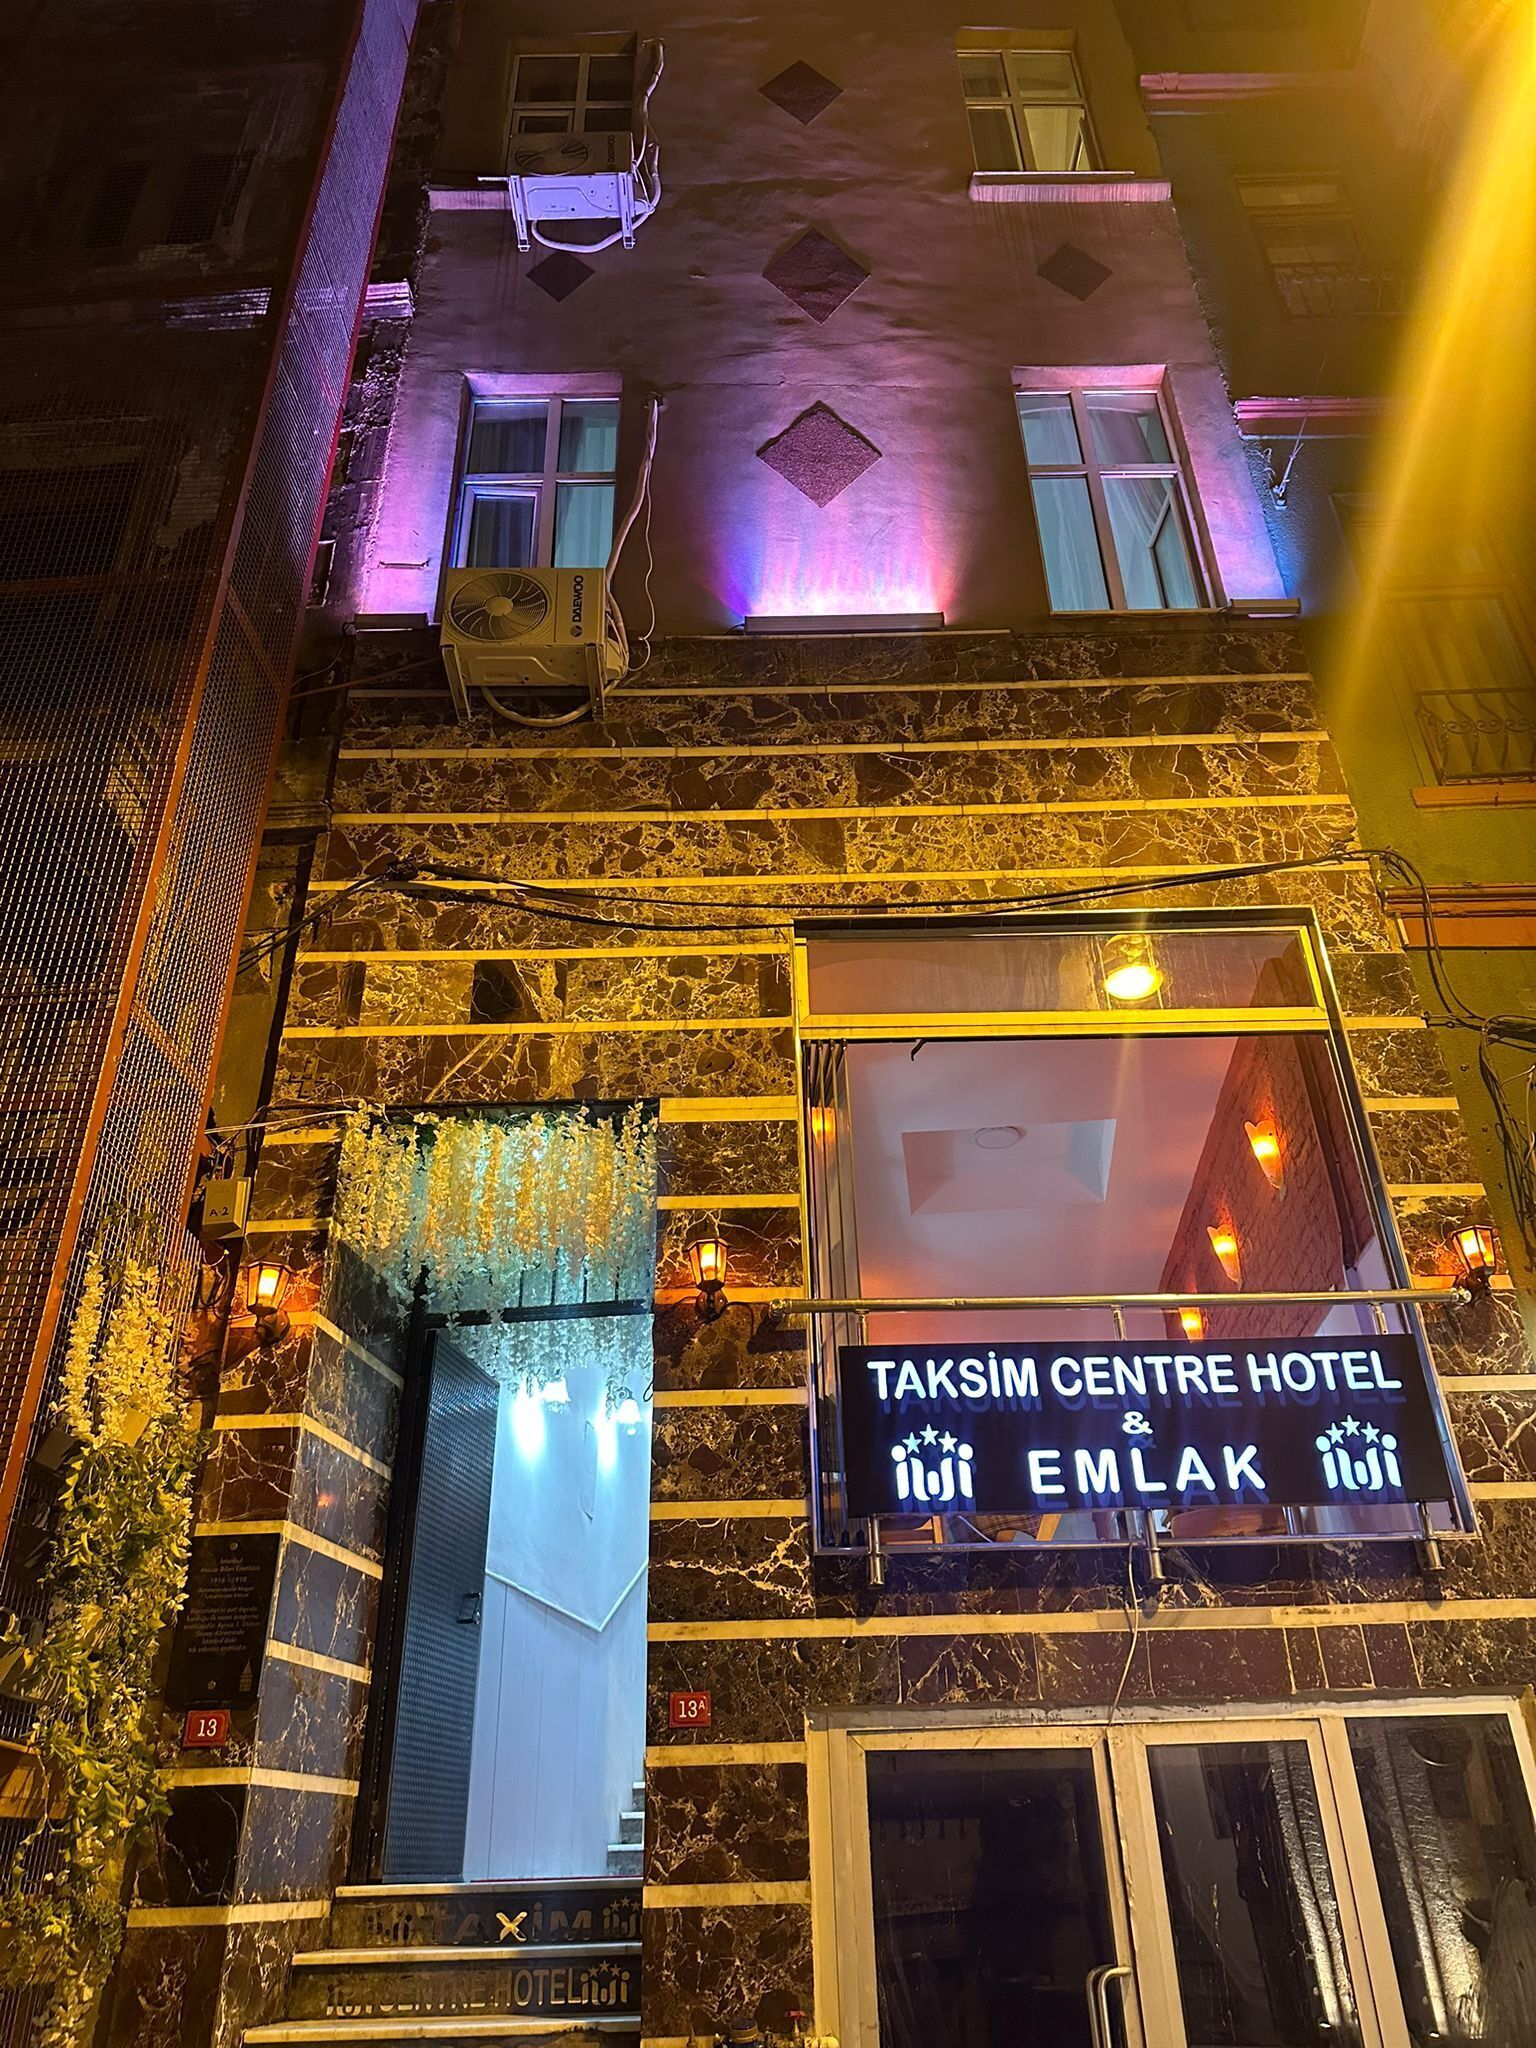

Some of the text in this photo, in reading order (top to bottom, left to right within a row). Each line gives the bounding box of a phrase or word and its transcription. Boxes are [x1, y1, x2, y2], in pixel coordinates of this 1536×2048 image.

[573, 575, 584, 622] DAEWOO
[867, 1350, 1403, 1400] TAKSİM CENTRE HOTEL
[1122, 1411, 1154, 1435] &
[1027, 1444, 1266, 1494] EMLAK
[198, 1719, 217, 1737] 13
[494, 1968, 581, 2007] HOTEL
